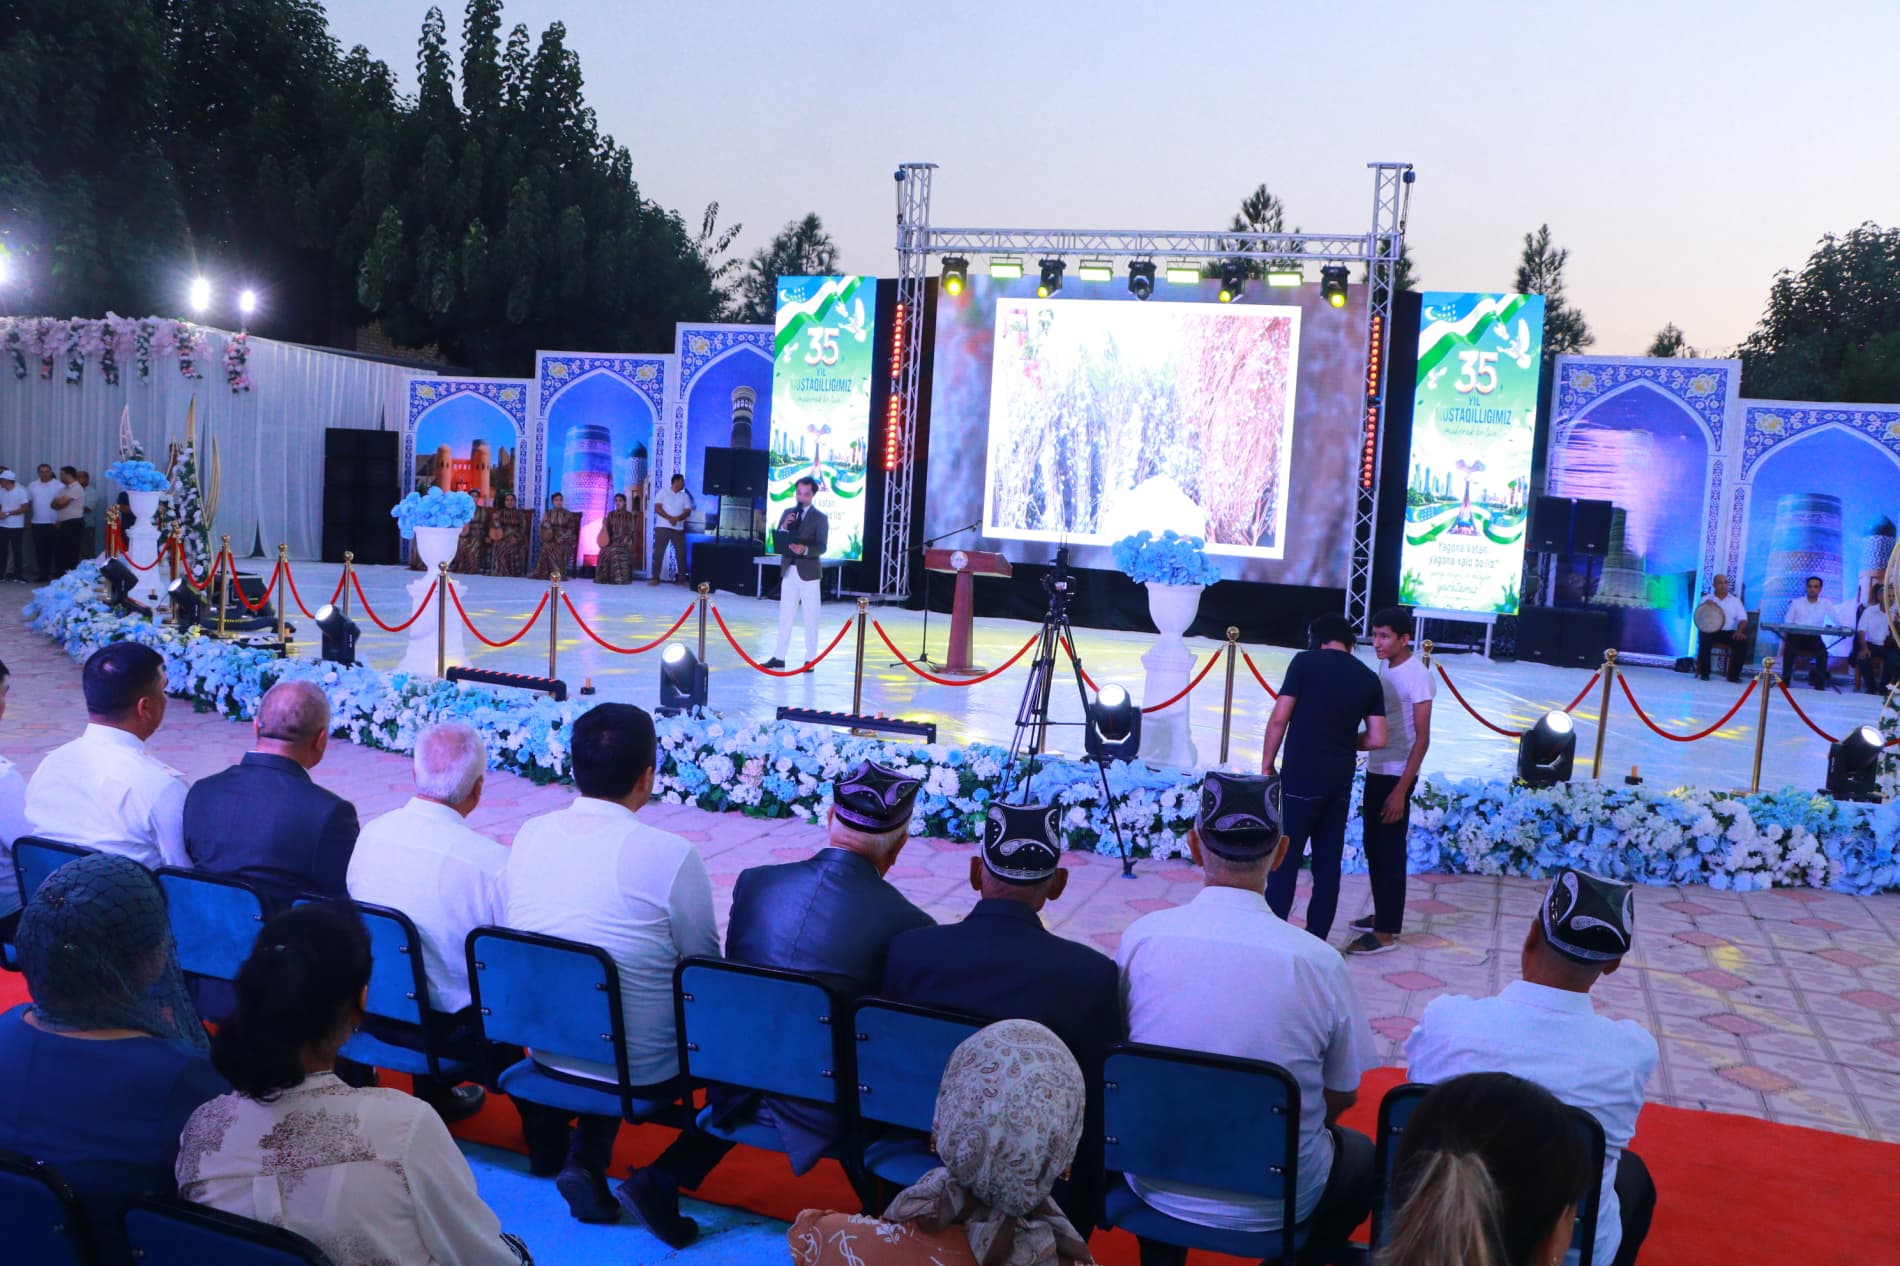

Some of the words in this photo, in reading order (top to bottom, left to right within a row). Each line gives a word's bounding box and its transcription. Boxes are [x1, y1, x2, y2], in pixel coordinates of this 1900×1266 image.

[804, 327, 839, 366] 35
[816, 367, 827, 377] YIL
[1454, 351, 1498, 395] 35
[791, 377, 852, 393] USTAQILLIGIMIZ
[1468, 395, 1481, 407] YIL
[1436, 407, 1512, 426] USTAQILLIGIMIZ
